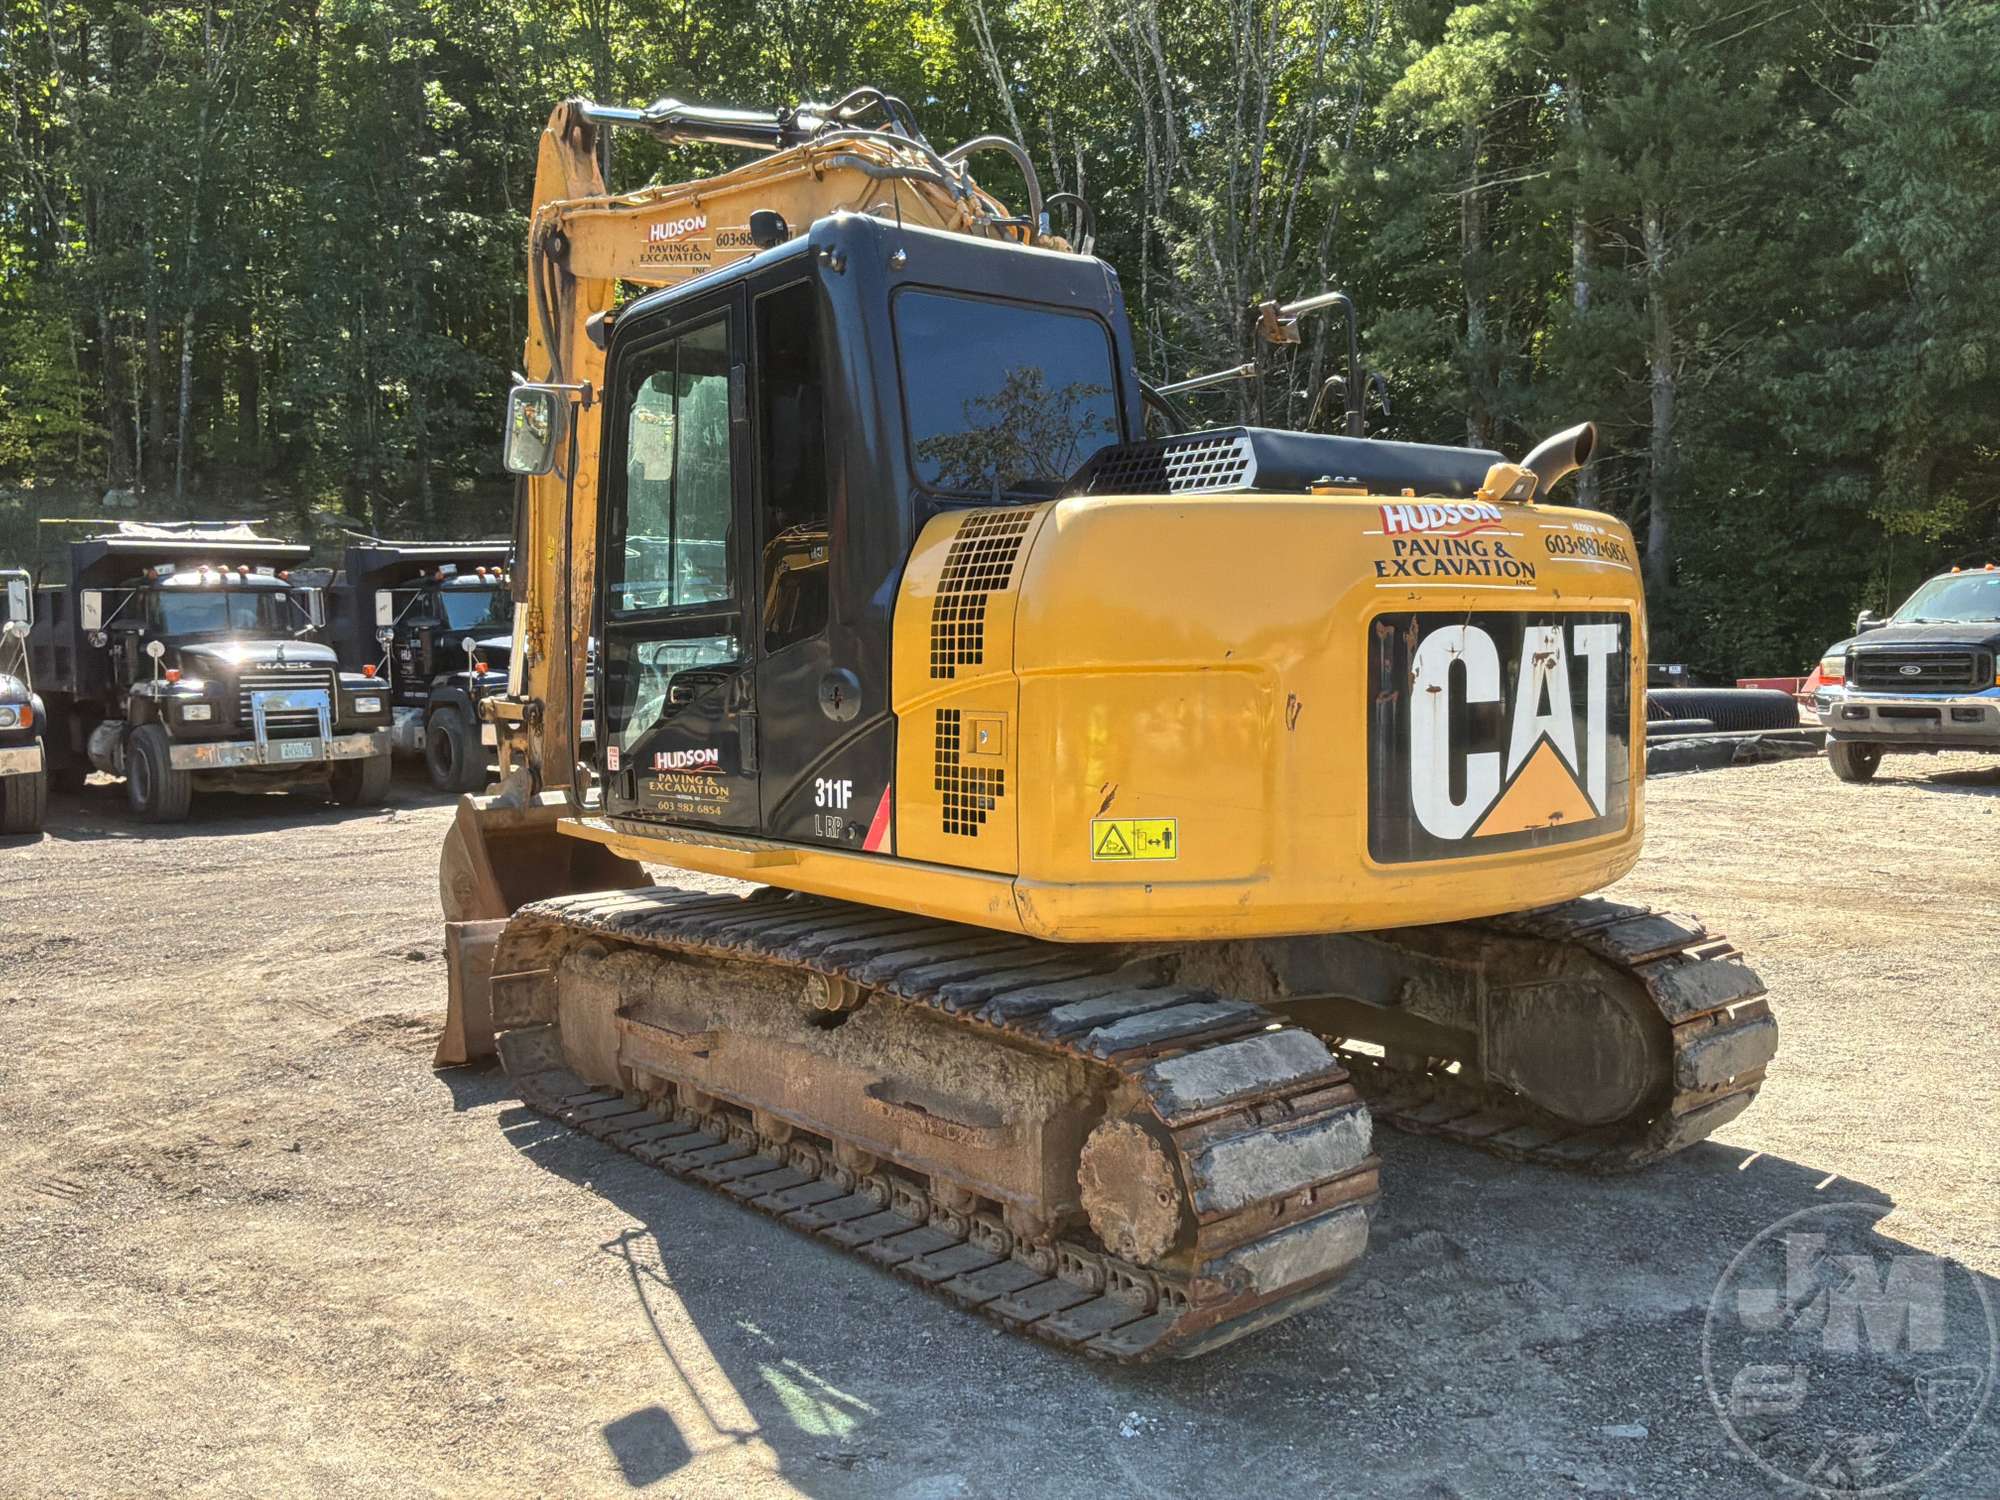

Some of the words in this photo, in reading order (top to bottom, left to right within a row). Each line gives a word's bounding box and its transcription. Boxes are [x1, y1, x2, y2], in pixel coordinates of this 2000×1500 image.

[650, 215, 707, 241] HUDSON
[640, 252, 711, 263] EXCAVATION
[650, 244, 690, 253] PAVING
[691, 244, 701, 253] &
[1379, 504, 1502, 535] HUDSON
[1392, 539, 1487, 558] PAVING
[1494, 541, 1513, 559] &
[1374, 558, 1536, 580] EXCAVATION
[256, 661, 313, 670] MACK
[1410, 623, 1618, 840] CAT
[655, 748, 718, 770] HUDSON
[649, 781, 729, 796] EXCAVATION
[658, 773, 704, 785] PAVING
[707, 776, 717, 787] &
[815, 777, 853, 810] 311F
[658, 800, 675, 811] 603
[697, 805, 721, 815] 6854
